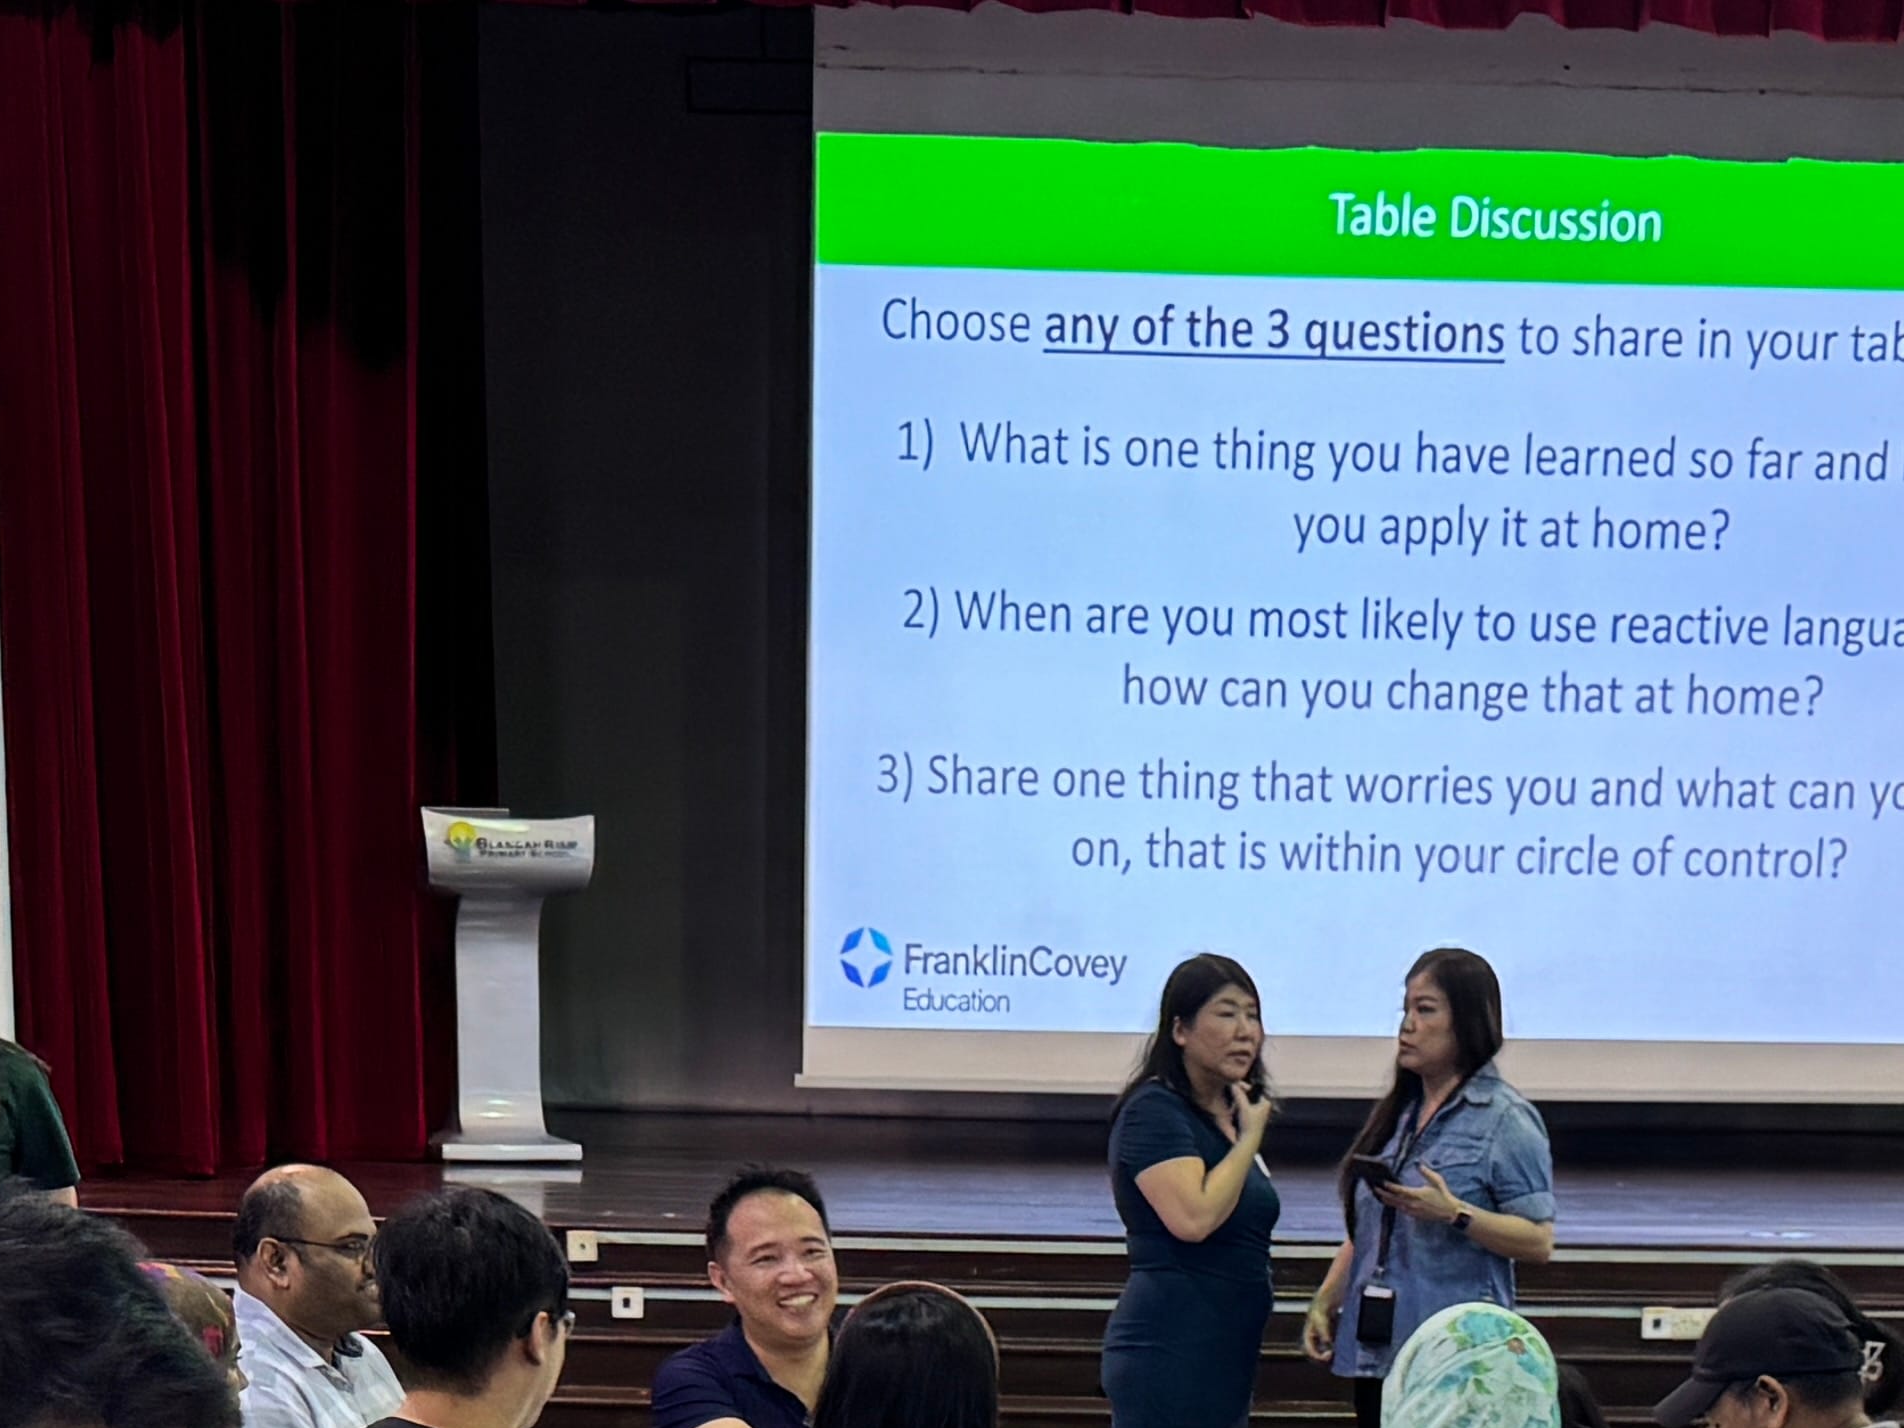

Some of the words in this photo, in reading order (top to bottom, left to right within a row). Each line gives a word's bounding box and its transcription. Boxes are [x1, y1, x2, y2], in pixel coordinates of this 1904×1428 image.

[1329, 191, 1437, 237] Table
[1451, 195, 1662, 242] Discussion
[883, 297, 1029, 342] Choose
[1043, 313, 1121, 355] any
[1133, 304, 1175, 345] of
[1186, 306, 1252, 348] the
[1268, 309, 1289, 348] 3
[1304, 311, 1505, 364] questions
[1520, 318, 1558, 355] to
[1573, 314, 1682, 357] share
[1699, 318, 1730, 358] in
[1747, 330, 1838, 370] your
[899, 418, 932, 470] 1)
[960, 421, 1068, 465] What
[1084, 426, 1109, 466] is
[1126, 437, 1198, 468] one
[1214, 427, 1315, 481] thing
[1329, 442, 1400, 482] you
[1417, 430, 1509, 474] have
[1526, 432, 1675, 477] learned
[1690, 449, 1733, 479] so
[1748, 437, 1802, 480] far
[1815, 440, 1888, 481] and
[1294, 514, 1365, 553] you
[1381, 504, 1489, 556] apply
[1503, 507, 1527, 547] it
[1541, 512, 1579, 548] at
[1593, 506, 1729, 550] home?
[904, 587, 938, 638] 2)
[955, 589, 1070, 632] When
[1087, 604, 1148, 634] are
[1163, 606, 1233, 645] you
[1250, 602, 1347, 639] most
[1363, 597, 1463, 650] likely
[1476, 605, 1515, 641] to
[1531, 613, 1596, 642] use
[1612, 606, 1768, 645] reactive
[1124, 663, 1208, 705] how
[1221, 678, 1286, 707] can
[1302, 680, 1372, 718] you
[1388, 668, 1528, 721] change
[1542, 671, 1622, 713] that
[1636, 678, 1673, 714] at
[1688, 673, 1823, 716] home?
[878, 752, 912, 803] 3)
[928, 753, 1038, 796] Share
[1054, 768, 1125, 798] one
[1139, 758, 1239, 810] thing
[1252, 760, 1332, 802] that
[1346, 765, 1492, 805] worries
[1506, 777, 1576, 815] you
[1591, 766, 1662, 807] and
[1677, 767, 1776, 808] what
[1789, 781, 1854, 809] can
[1072, 838, 1131, 875] on,
[1146, 827, 1226, 869] that
[1240, 831, 1266, 870] is
[1280, 830, 1400, 872] within
[1415, 844, 1504, 882] your
[1517, 834, 1618, 876] circle
[1633, 835, 1674, 876] of
[1685, 837, 1847, 878] control?
[905, 944, 1127, 986] FranklinCovey
[904, 987, 1010, 1012] Education
